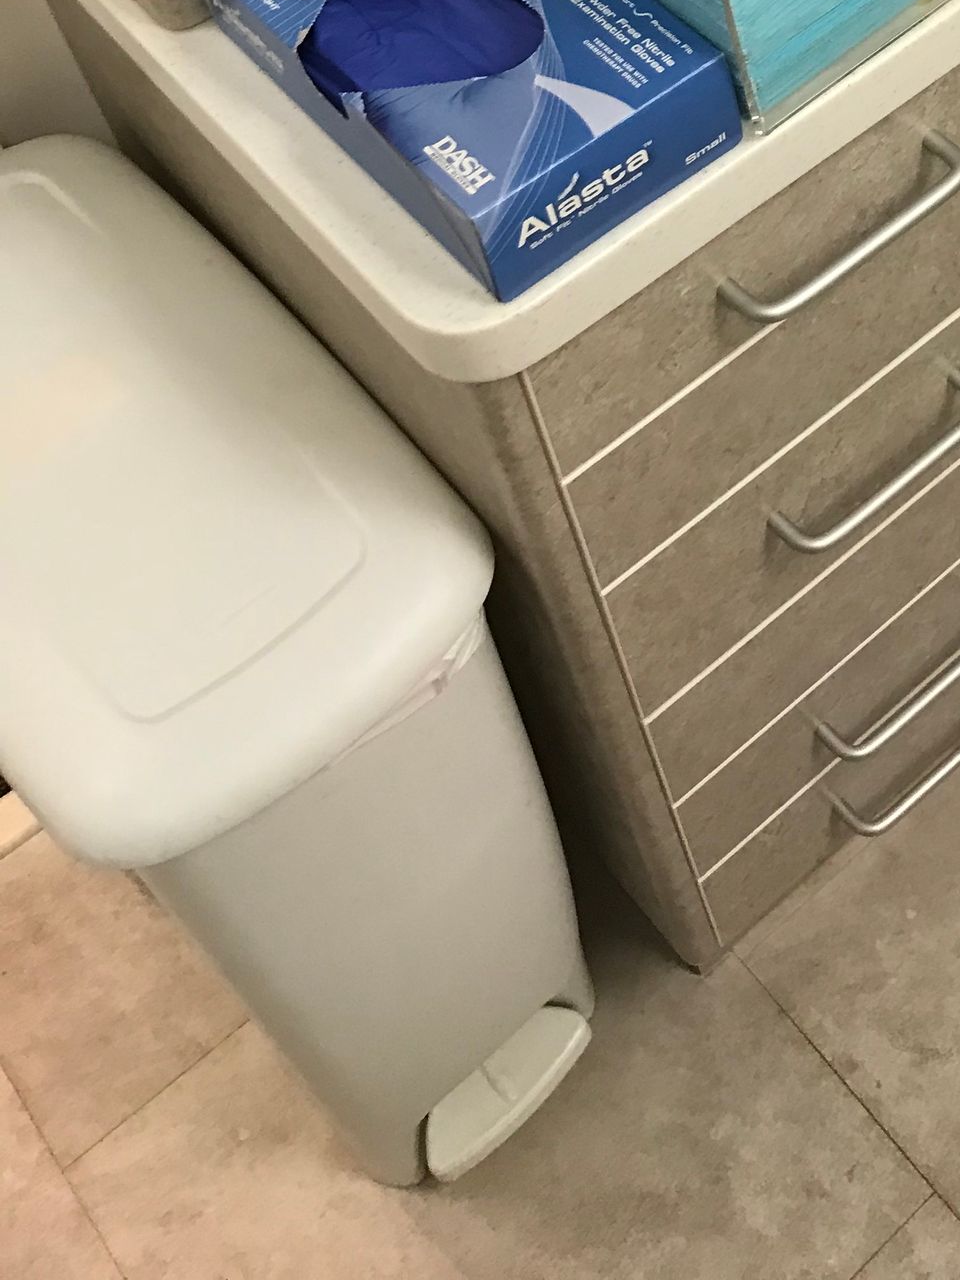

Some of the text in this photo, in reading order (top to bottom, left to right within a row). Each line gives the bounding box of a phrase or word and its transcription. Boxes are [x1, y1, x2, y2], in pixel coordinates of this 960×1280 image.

[616, 17, 642, 39] Free
[641, 38, 677, 67] Nitrile
[650, 19, 682, 45] Precision
[630, 43, 666, 73] Gloves
[621, 71, 642, 89] DRUGS
[431, 135, 497, 189] DASH
[684, 131, 727, 166] Small
[529, 232, 554, 250] Soft
[578, 193, 610, 217] Nitrile
[611, 171, 644, 195] Gloves
